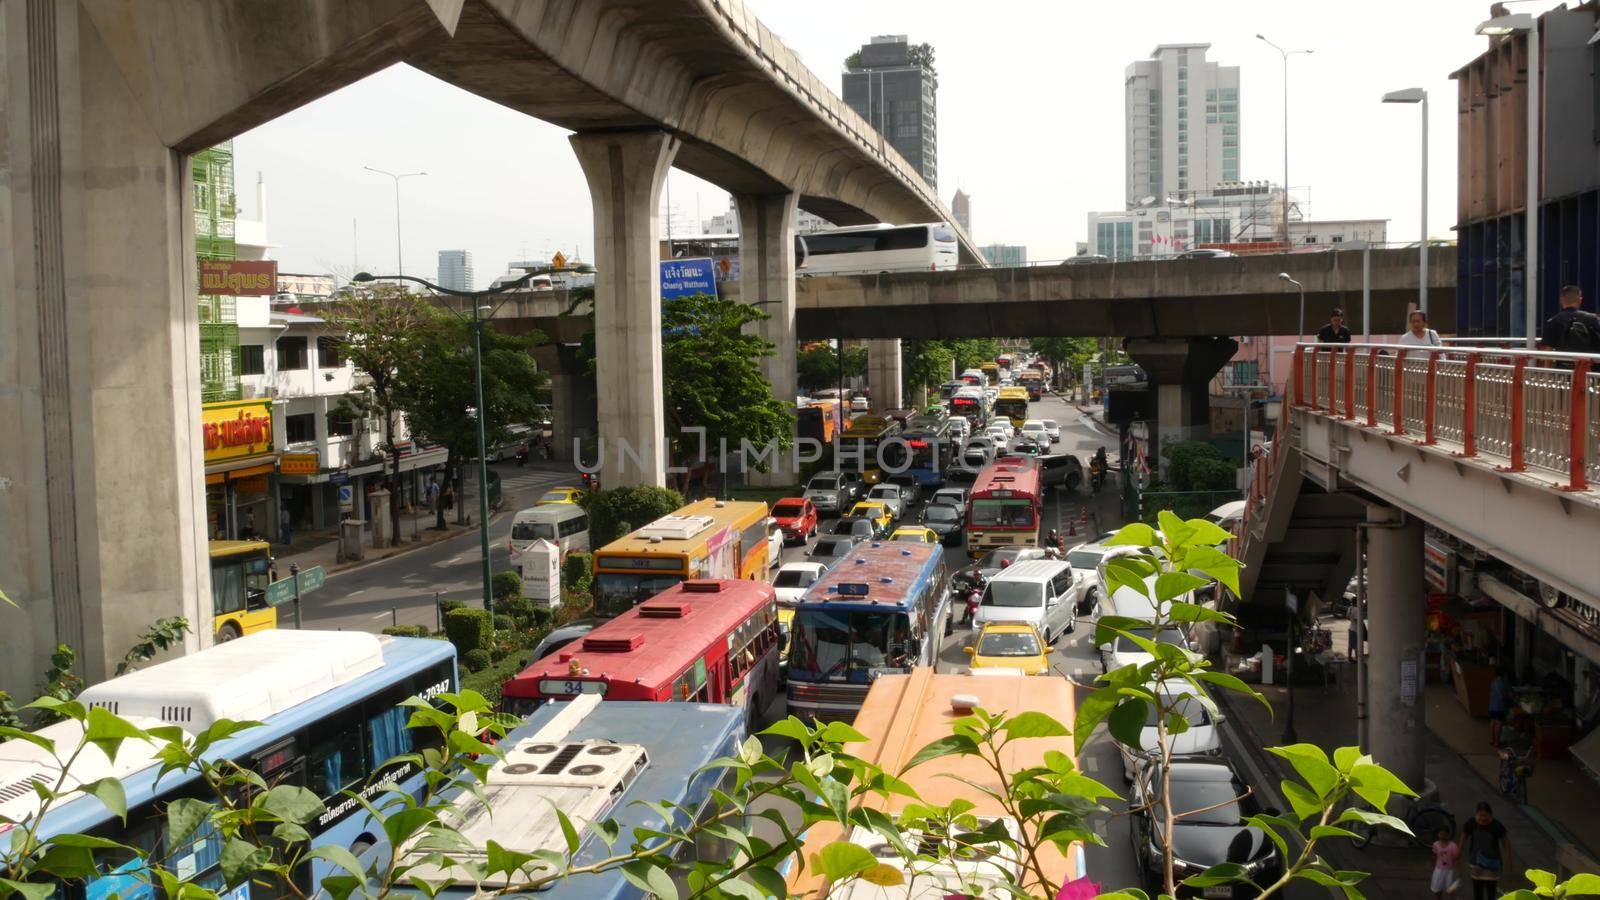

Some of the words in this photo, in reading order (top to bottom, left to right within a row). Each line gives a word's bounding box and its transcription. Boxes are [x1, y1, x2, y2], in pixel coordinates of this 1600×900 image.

[665, 266, 703, 279] แจ้งวัฒนะ
[203, 270, 271, 294] แม่สุพร
[564, 681, 584, 694] 34
